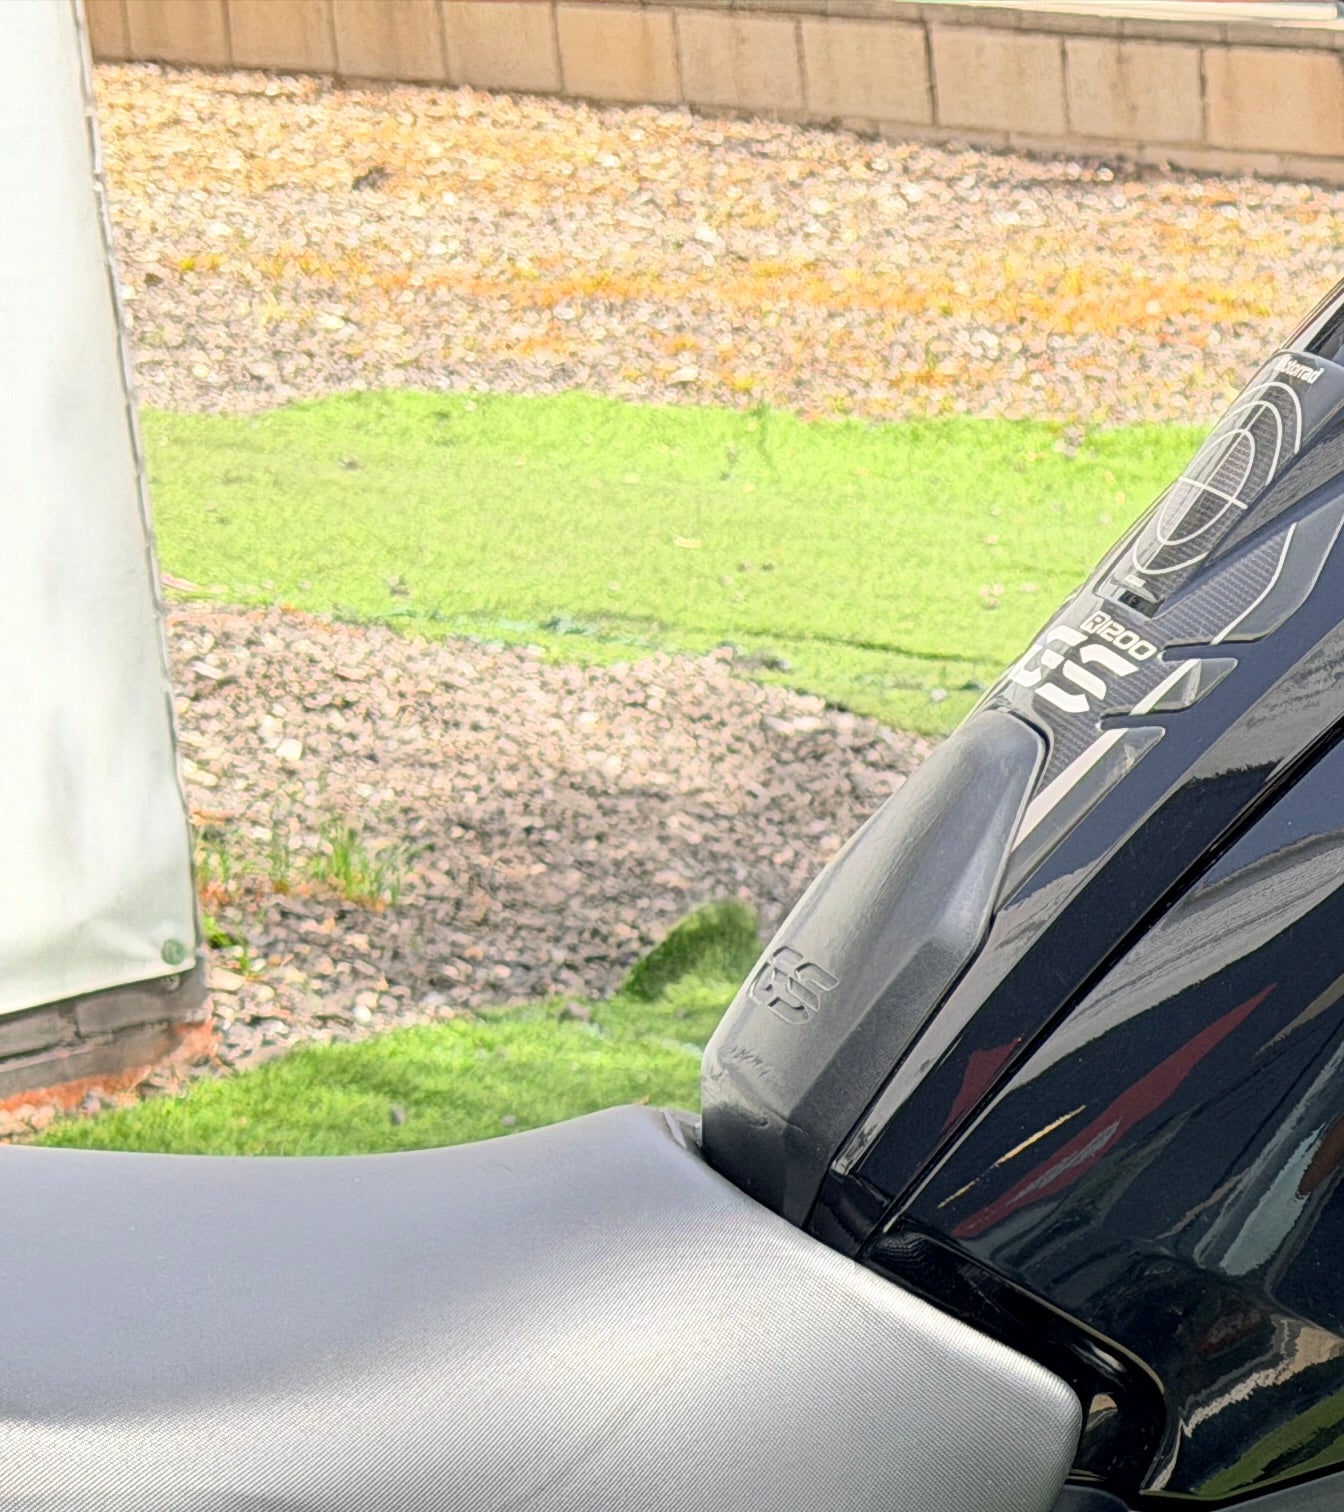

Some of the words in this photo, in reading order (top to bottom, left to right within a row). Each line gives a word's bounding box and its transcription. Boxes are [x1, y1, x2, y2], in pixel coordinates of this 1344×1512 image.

[1008, 624, 1140, 714] GS
[1080, 610, 1158, 661] R1200
[749, 945, 840, 1025] GS
